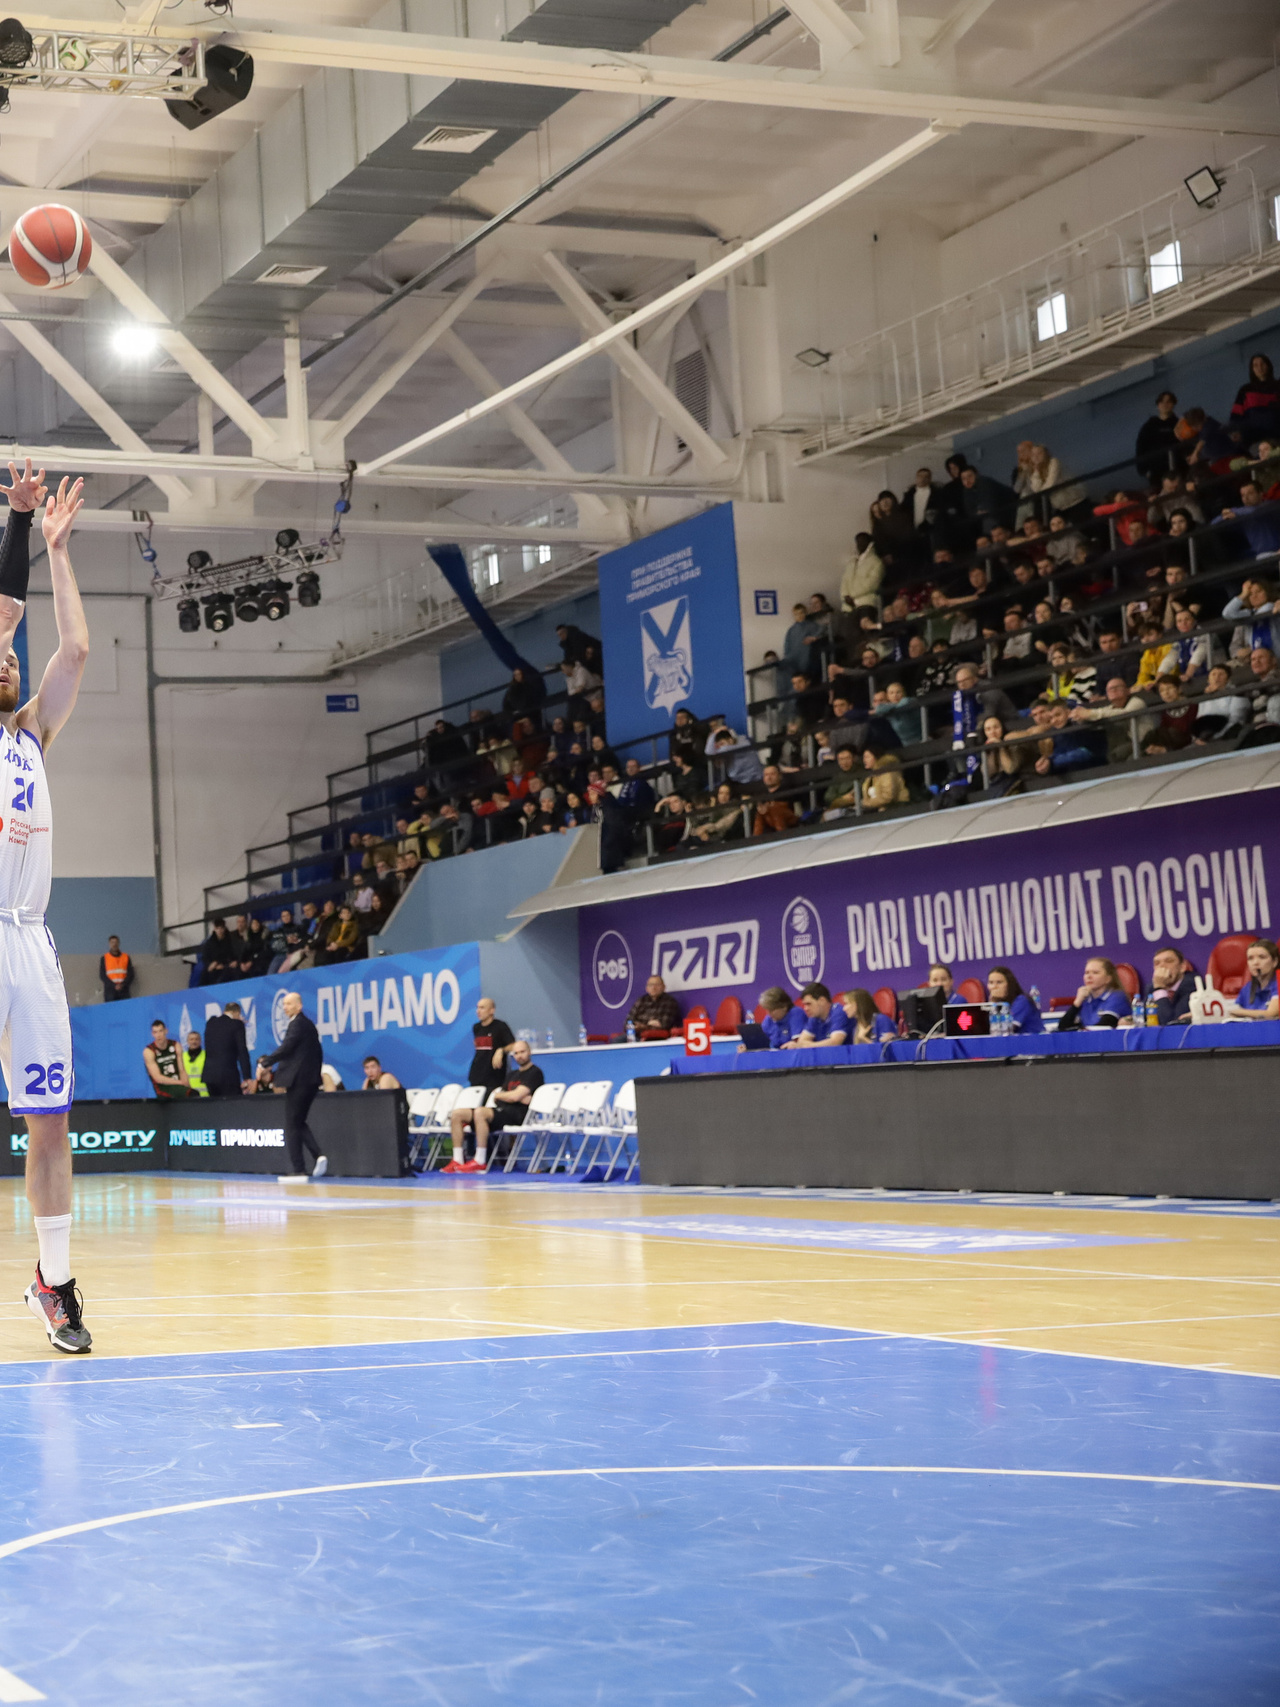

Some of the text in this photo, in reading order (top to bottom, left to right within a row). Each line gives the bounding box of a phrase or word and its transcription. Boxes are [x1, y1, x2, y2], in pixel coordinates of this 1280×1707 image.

[846, 897, 911, 973] PARI
[1111, 845, 1271, 944] РОССИИ
[597, 957, 628, 982] РФБ
[656, 928, 753, 983] PARI
[317, 968, 461, 1044] ДИНАМО
[687, 1022, 709, 1052] 5
[24, 1062, 65, 1096] 26
[68, 1129, 157, 1149] ОРТУ
[169, 1128, 286, 1147] ЛУЧШЕЕ ПРИЛОЖЕ
